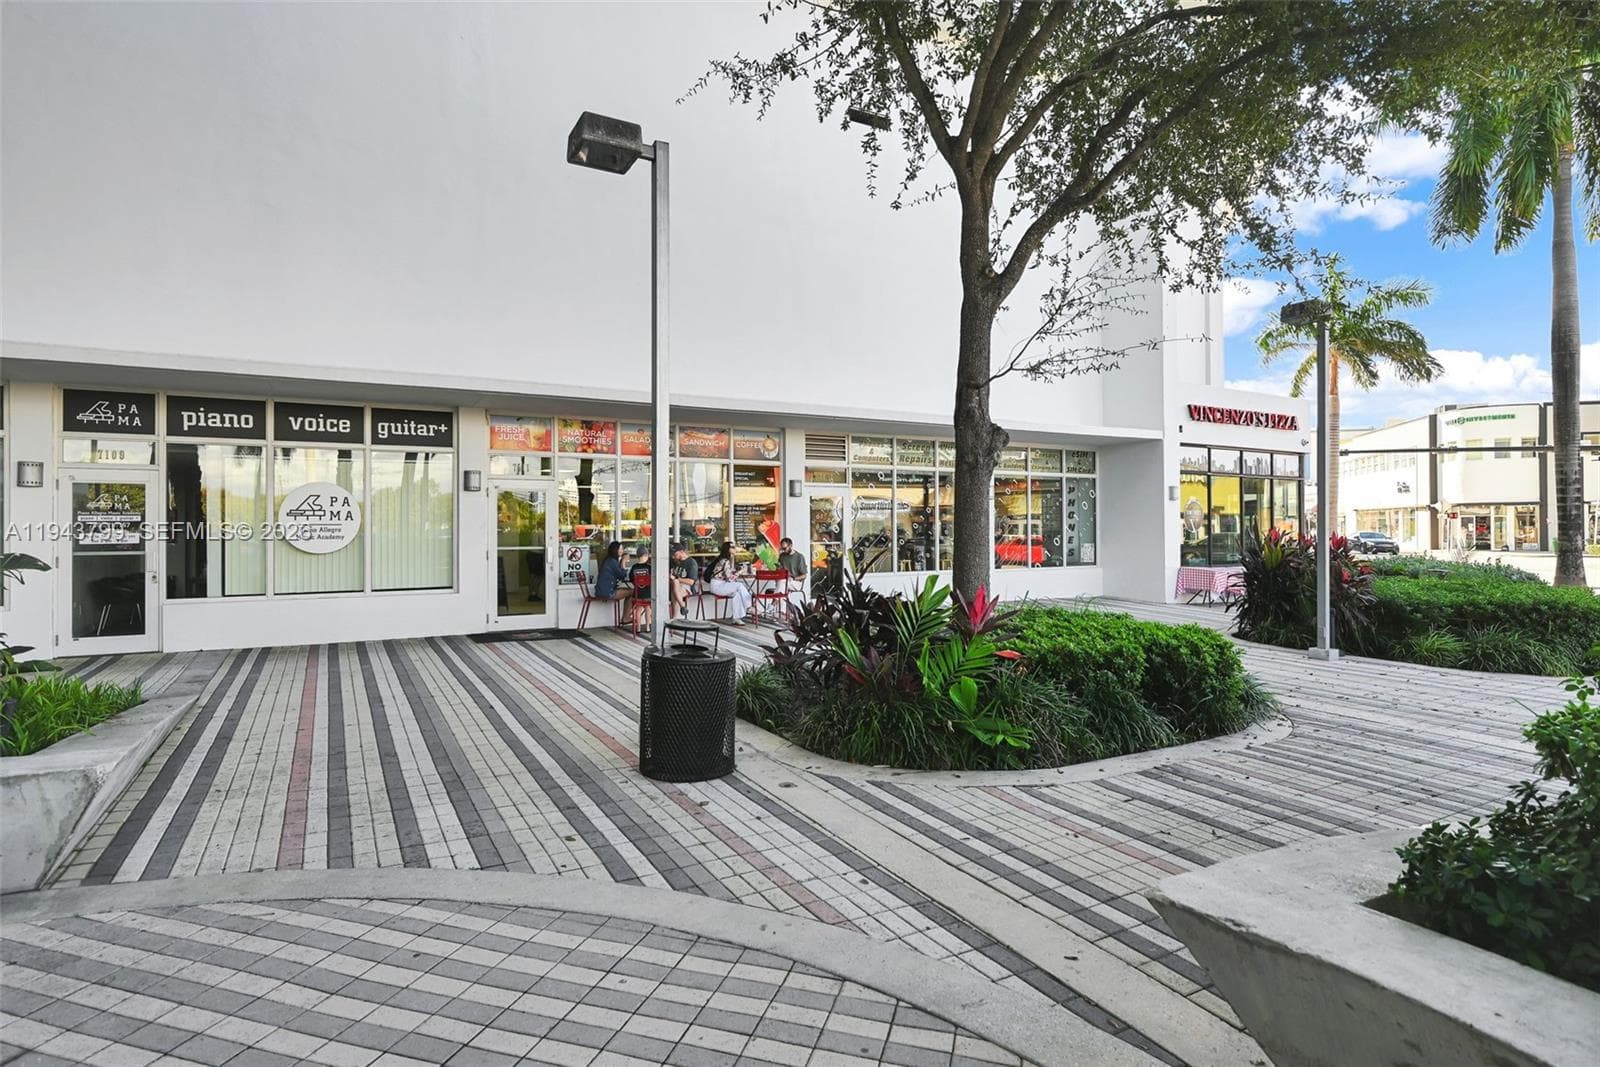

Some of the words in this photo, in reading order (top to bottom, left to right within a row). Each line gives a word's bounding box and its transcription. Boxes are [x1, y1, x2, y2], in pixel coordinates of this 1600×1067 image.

[181, 407, 254, 431] piano
[288, 413, 351, 433] voice
[377, 419, 448, 439] guitar+
[494, 424, 525, 433] FRESH
[566, 428, 607, 438] NATURAL
[497, 432, 526, 440] JUICE
[562, 436, 612, 446] SMOOTHIES
[683, 438, 726, 447] SANDWICH
[735, 441, 762, 449] COFFE
[901, 442, 931, 452] Screen
[97, 449, 126, 461] 7109
[899, 454, 933, 465] Repairs
[567, 563, 582, 571] NO
